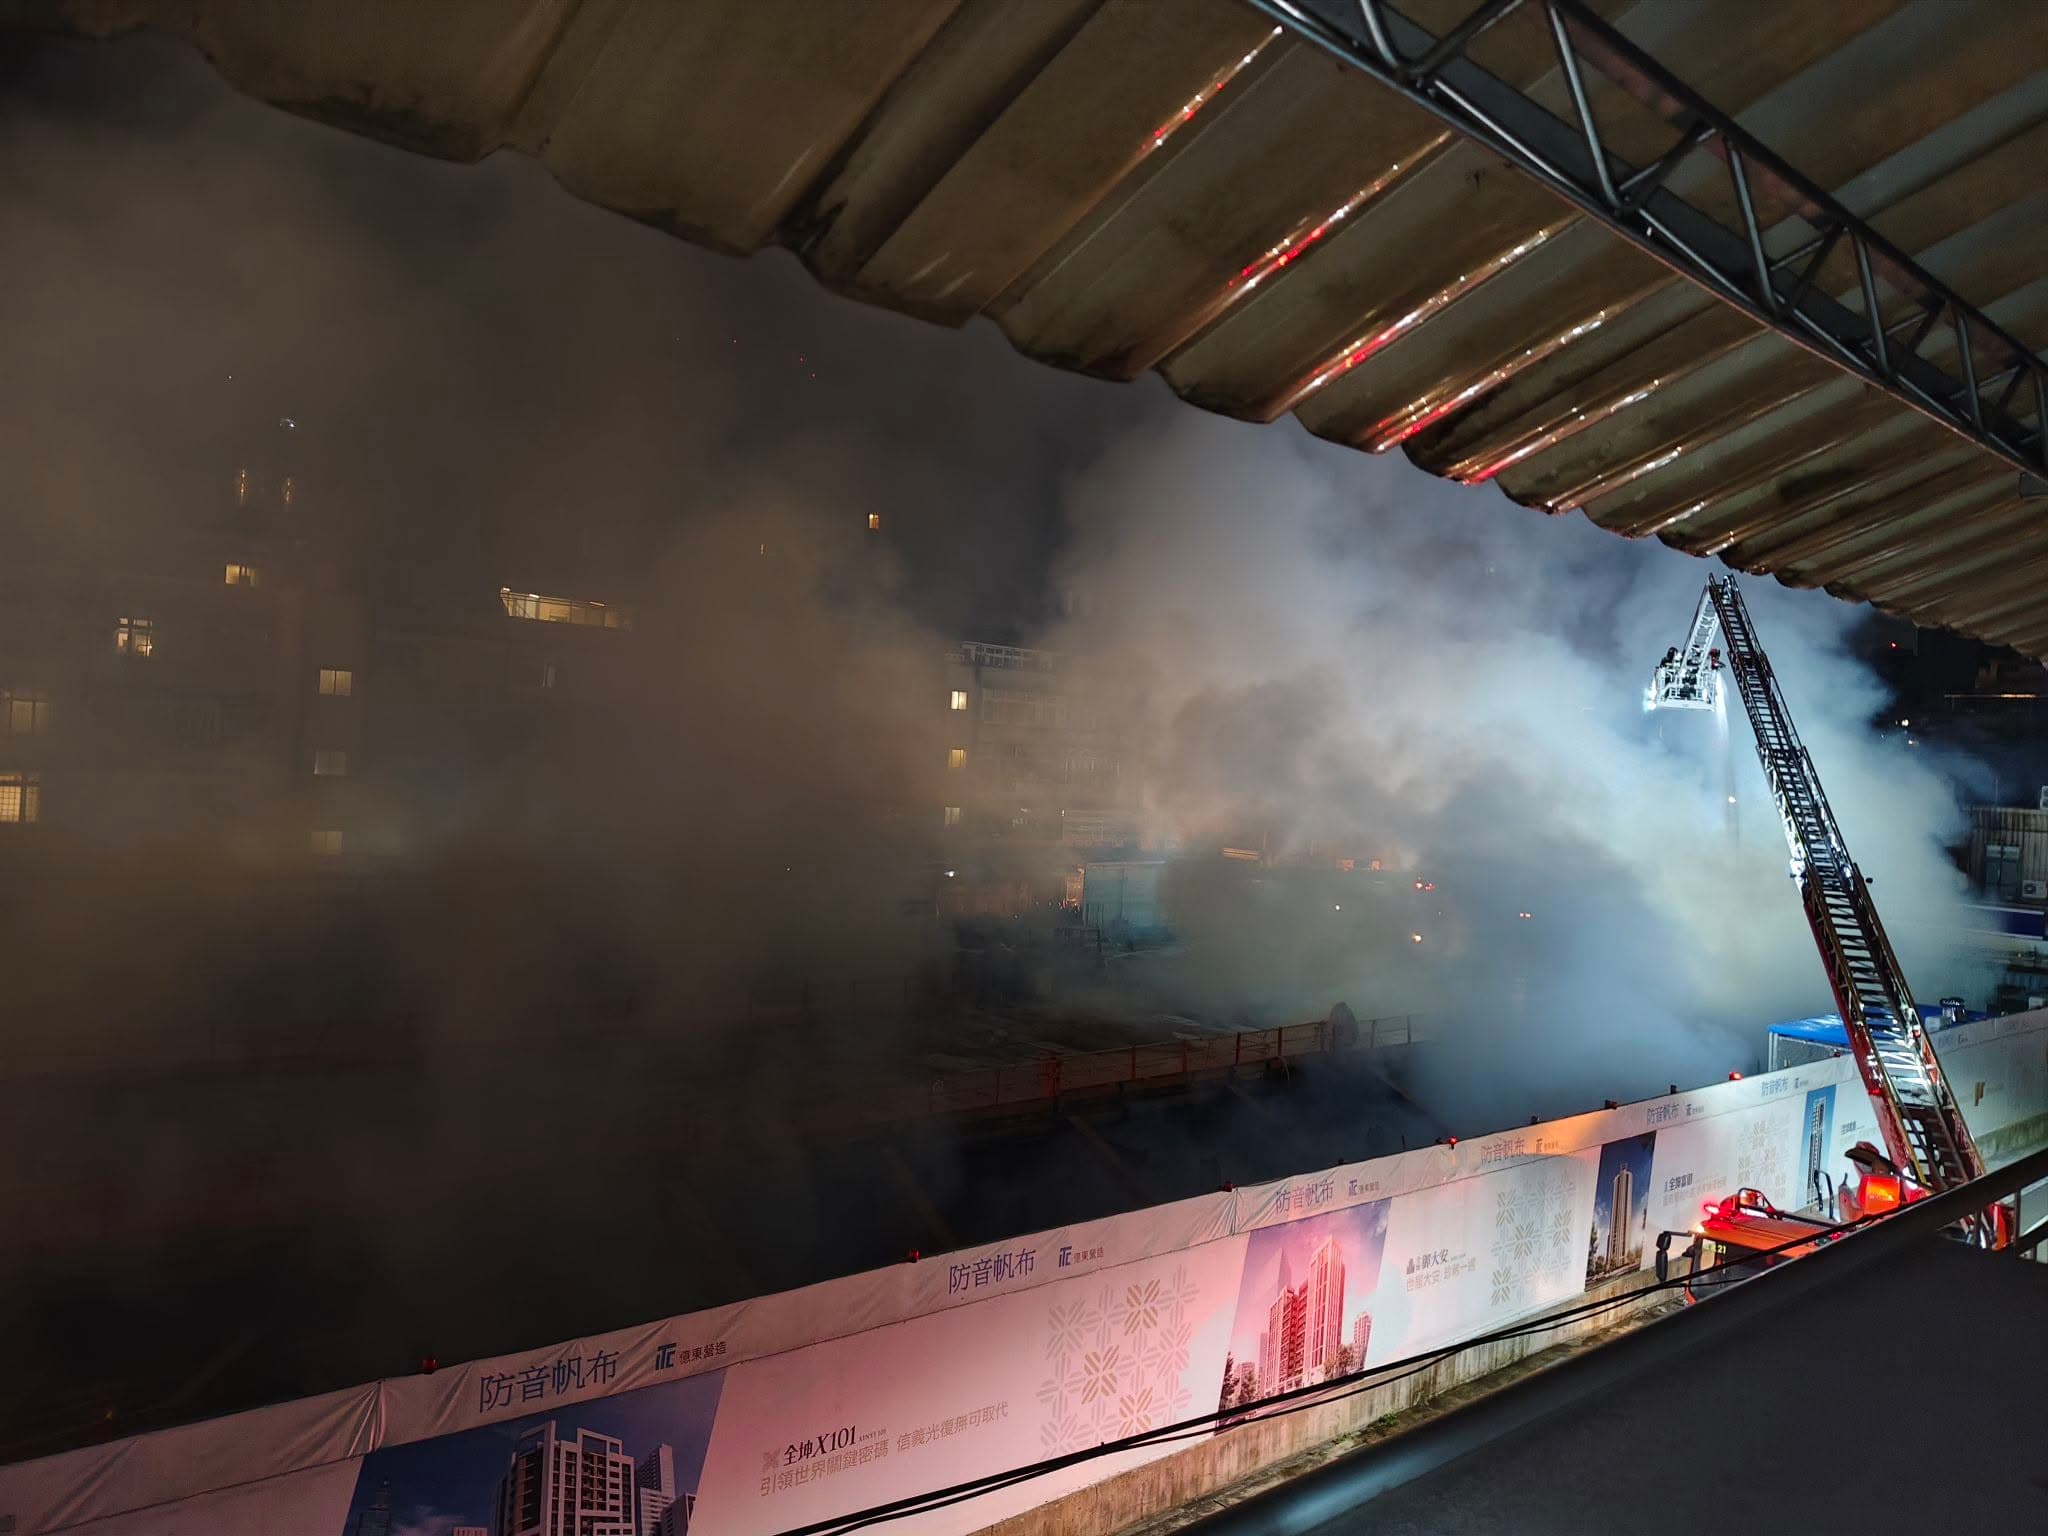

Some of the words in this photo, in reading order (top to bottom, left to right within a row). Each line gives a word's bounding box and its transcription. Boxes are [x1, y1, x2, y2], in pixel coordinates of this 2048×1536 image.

[1276, 1179, 1335, 1214] 防音帆布
[948, 1247, 1036, 1295] 防音帆布
[479, 1349, 620, 1413] 防音帆布
[761, 1439, 890, 1497] 引領世界關鍵密碼
[897, 1400, 1009, 1453] 信義光復無可取代
[783, 1425, 857, 1467] 全坤X101
